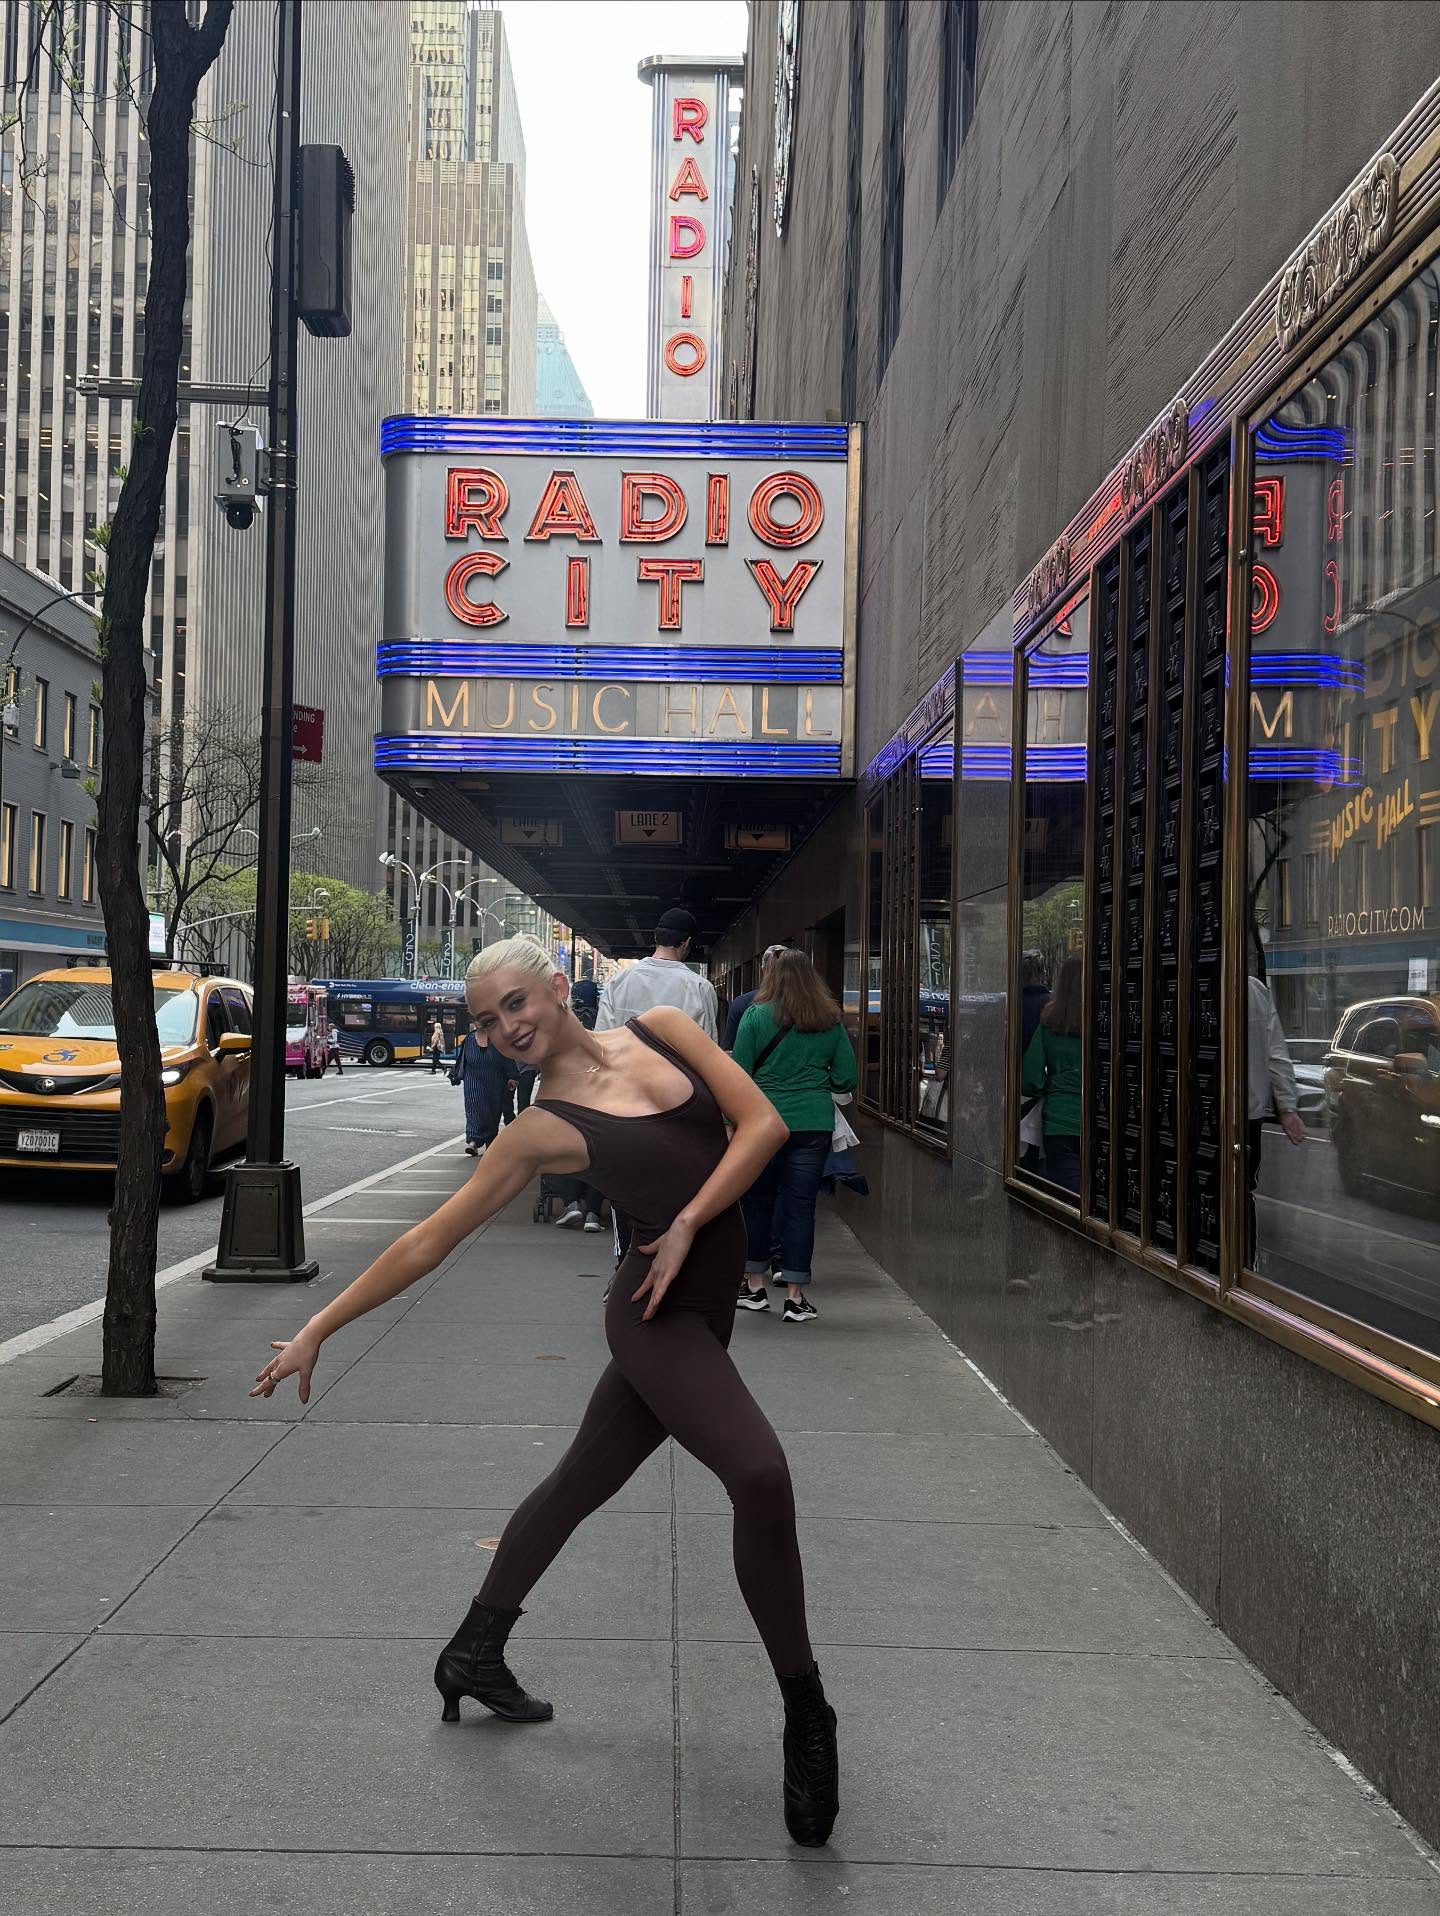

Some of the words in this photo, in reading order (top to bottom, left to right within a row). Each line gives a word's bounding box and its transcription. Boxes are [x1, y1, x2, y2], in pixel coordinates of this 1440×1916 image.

[664, 97, 709, 376] RADIO
[444, 466, 825, 550] RADIO
[444, 551, 824, 633] CITY
[293, 710, 315, 723] NDING
[426, 680, 631, 732] MUSIC
[664, 687, 833, 736] HALL
[631, 813, 659, 826] LANE
[662, 813, 670, 826] 2
[1332, 786, 1373, 863] MUSIC
[1376, 778, 1414, 850] HALL
[1328, 905, 1424, 938] RADIOCITY.COM
[410, 982, 466, 991] clean-ener
